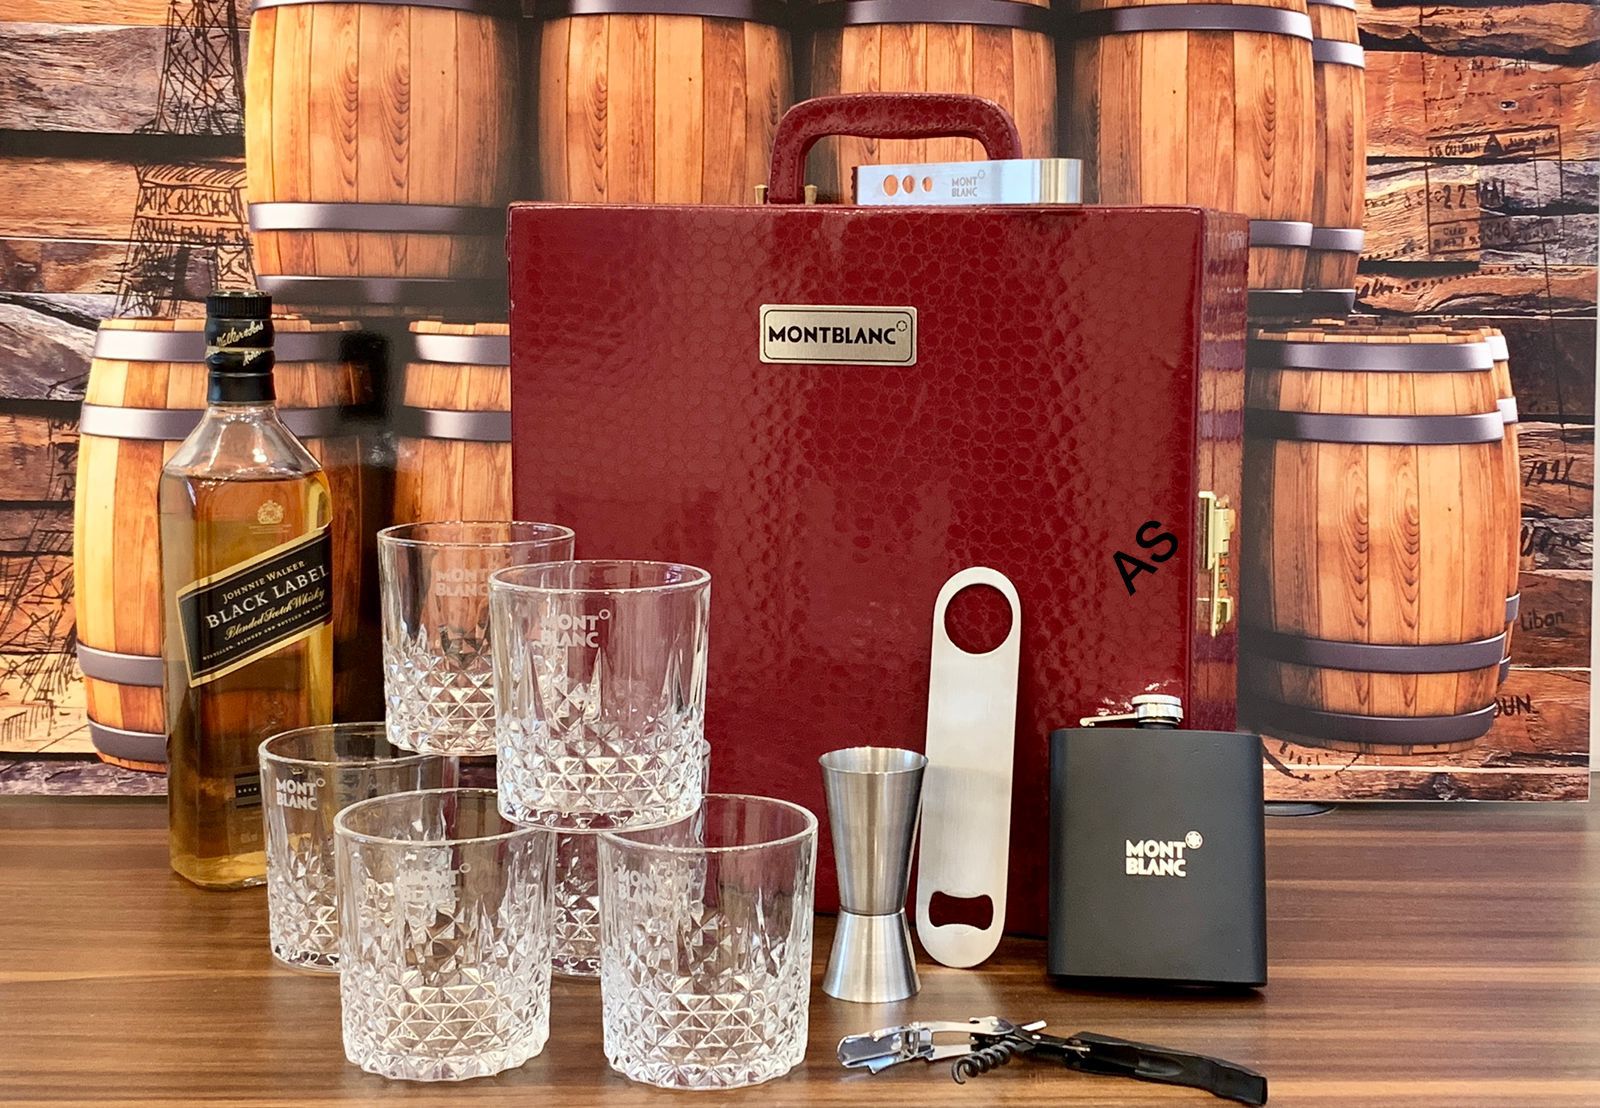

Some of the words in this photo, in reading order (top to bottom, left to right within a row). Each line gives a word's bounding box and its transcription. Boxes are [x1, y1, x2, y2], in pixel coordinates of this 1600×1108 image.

[951, 177, 978, 187] MONT
[951, 187, 978, 198] BLANC
[768, 325, 896, 345] MONTBLANC
[223, 580, 265, 604] JOHNNIE
[265, 560, 306, 582] WALKER
[206, 591, 269, 629] BLACK
[272, 565, 328, 599] LABEL
[540, 614, 599, 631] MONT
[540, 632, 599, 648] BLANC
[276, 778, 317, 797] MONT
[276, 791, 318, 811] BLANC
[1125, 839, 1187, 859] MONT
[1125, 857, 1187, 878] BLANC
